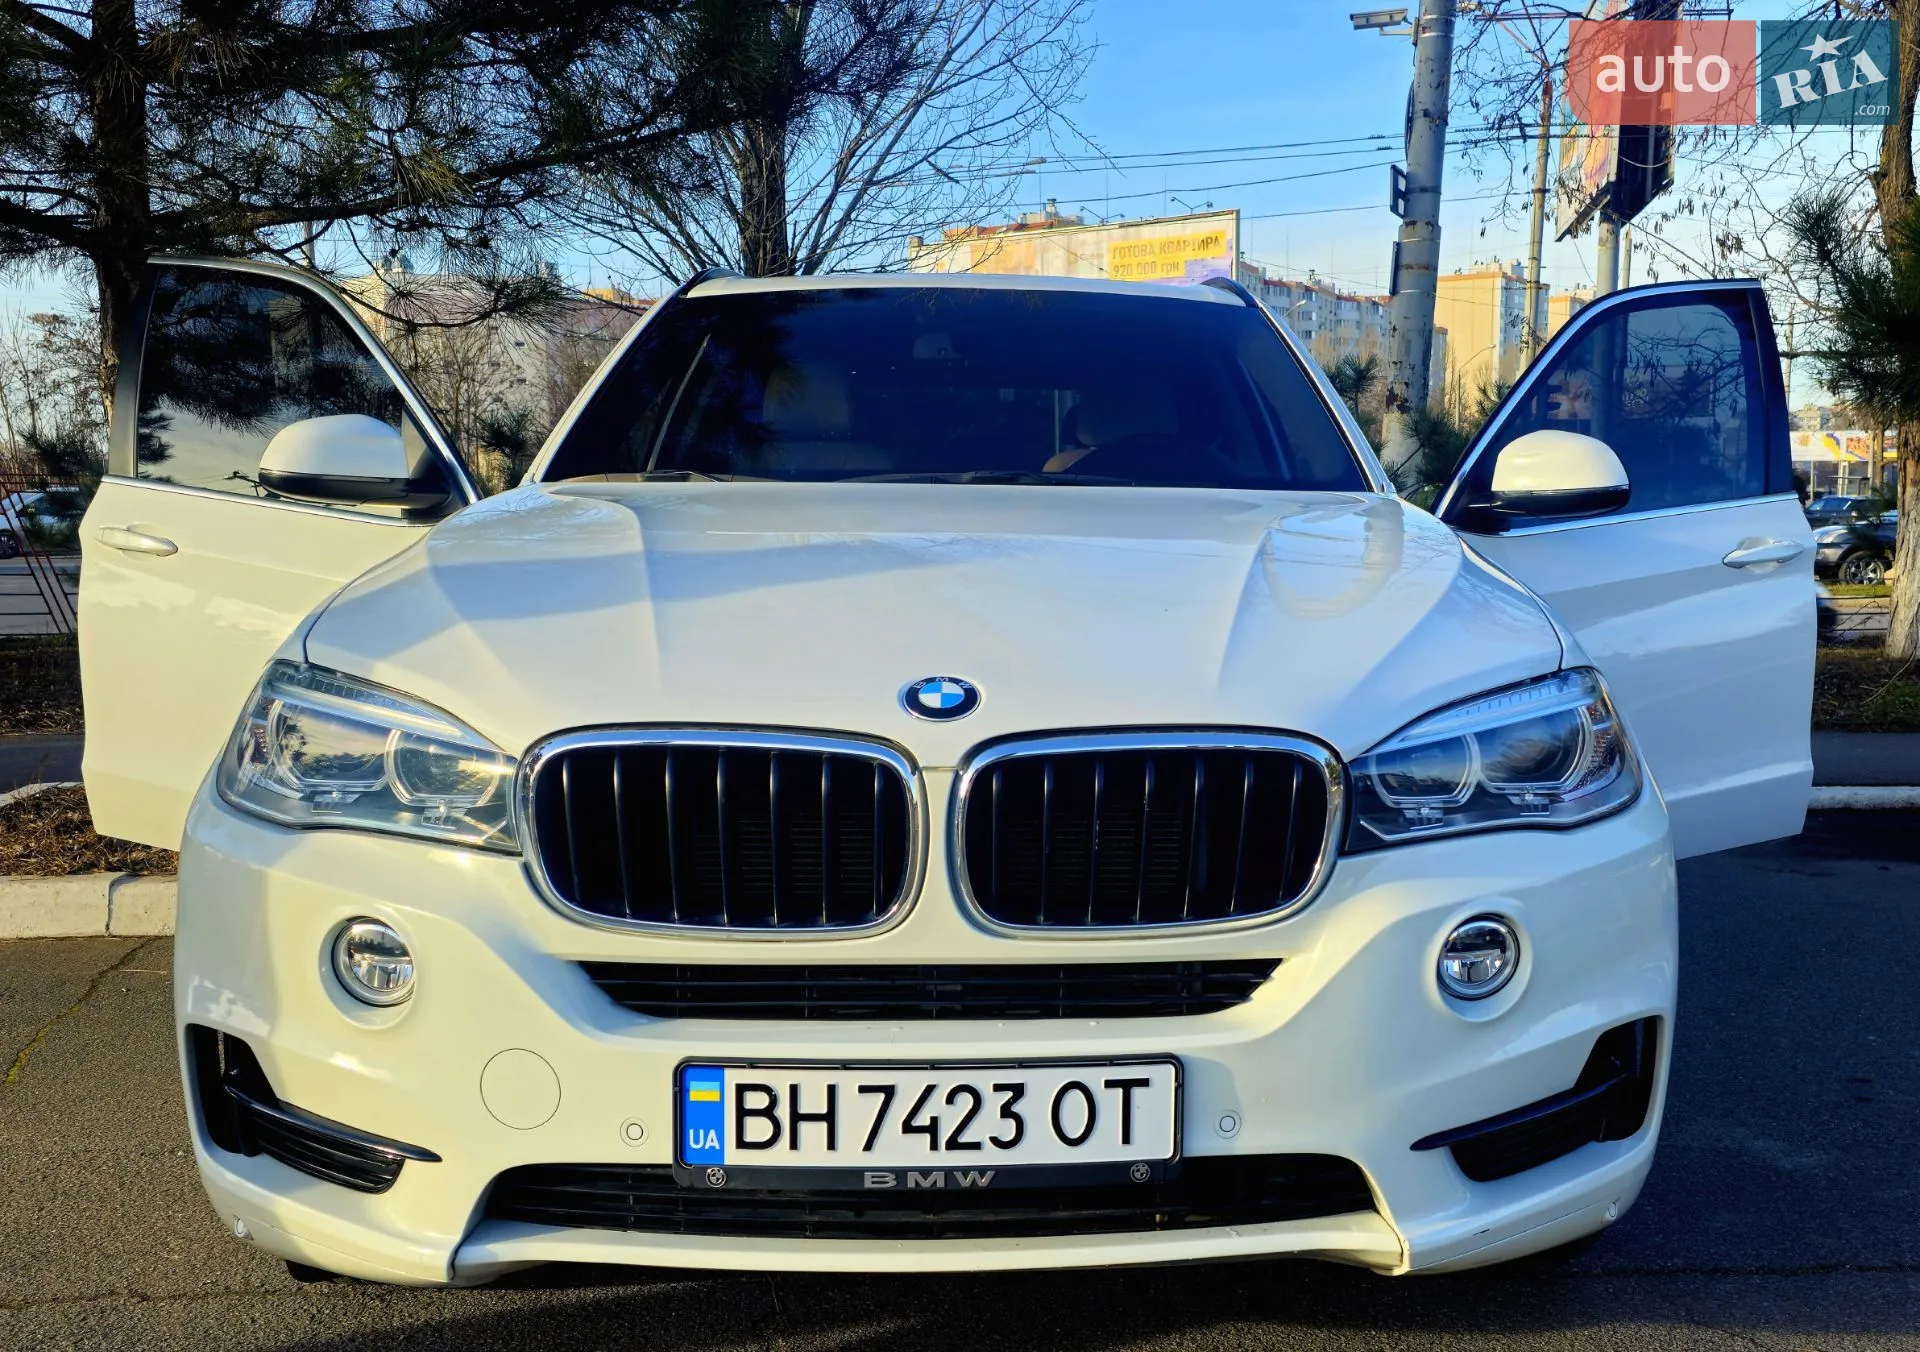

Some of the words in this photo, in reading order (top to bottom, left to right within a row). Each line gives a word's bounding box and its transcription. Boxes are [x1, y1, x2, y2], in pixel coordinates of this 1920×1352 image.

[1113, 243, 1156, 259] ГОТОВА
[1160, 235, 1221, 255] КВАРТИРА
[1136, 260, 1157, 275] 000
[1160, 261, 1179, 275] грн
[912, 677, 972, 689] BMW
[734, 1082, 836, 1152] BH
[857, 1082, 1026, 1152] 7423
[1049, 1077, 1151, 1147] OT
[689, 1127, 720, 1150] UA
[863, 1170, 996, 1188] BMW
